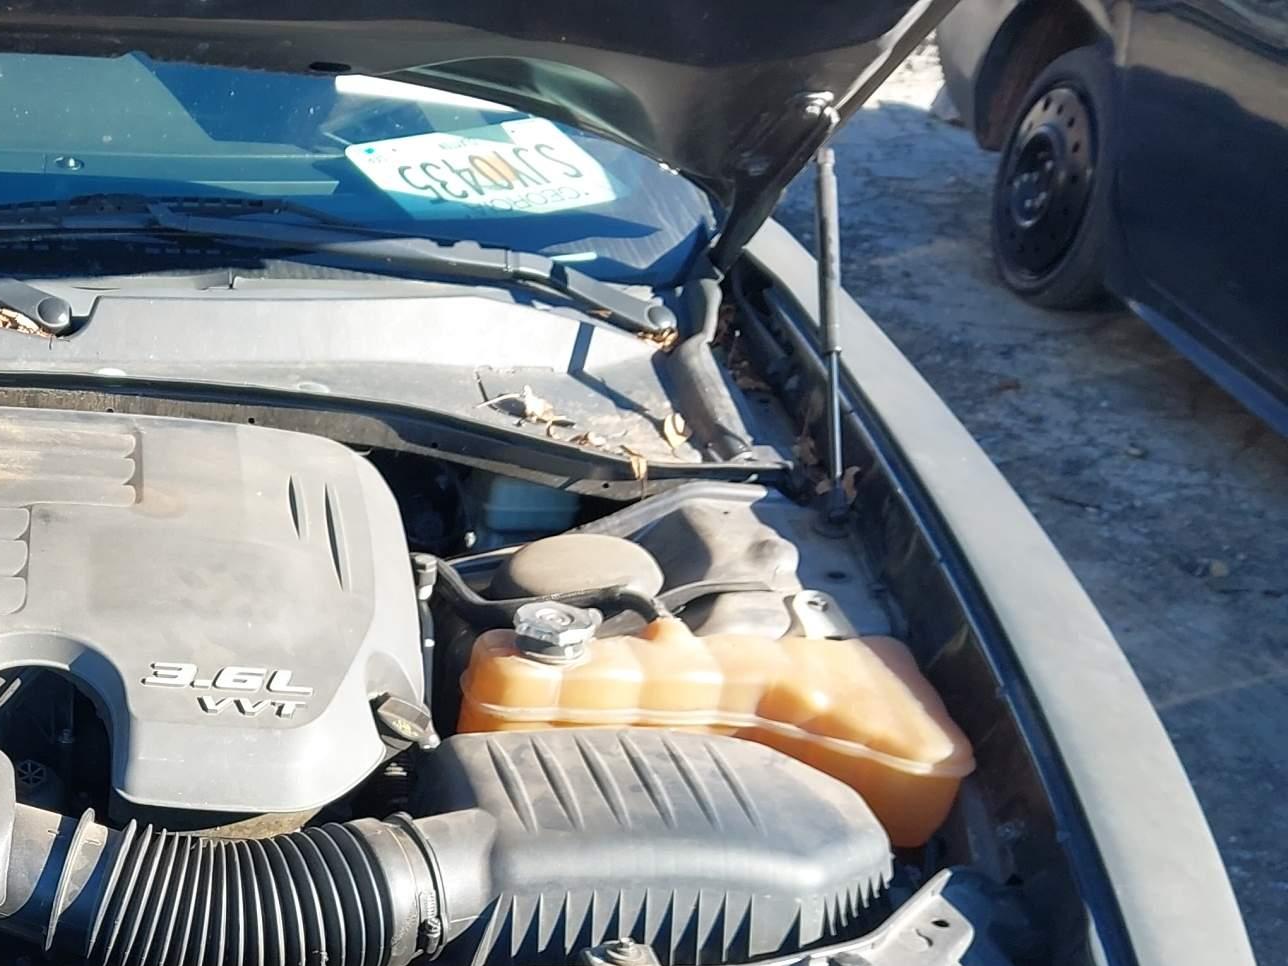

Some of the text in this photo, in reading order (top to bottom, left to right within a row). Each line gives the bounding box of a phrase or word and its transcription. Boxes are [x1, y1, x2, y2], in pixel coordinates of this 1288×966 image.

[397, 144, 583, 204] SJY0435
[140, 662, 313, 696] 3.6L
[196, 696, 309, 719] VVT
